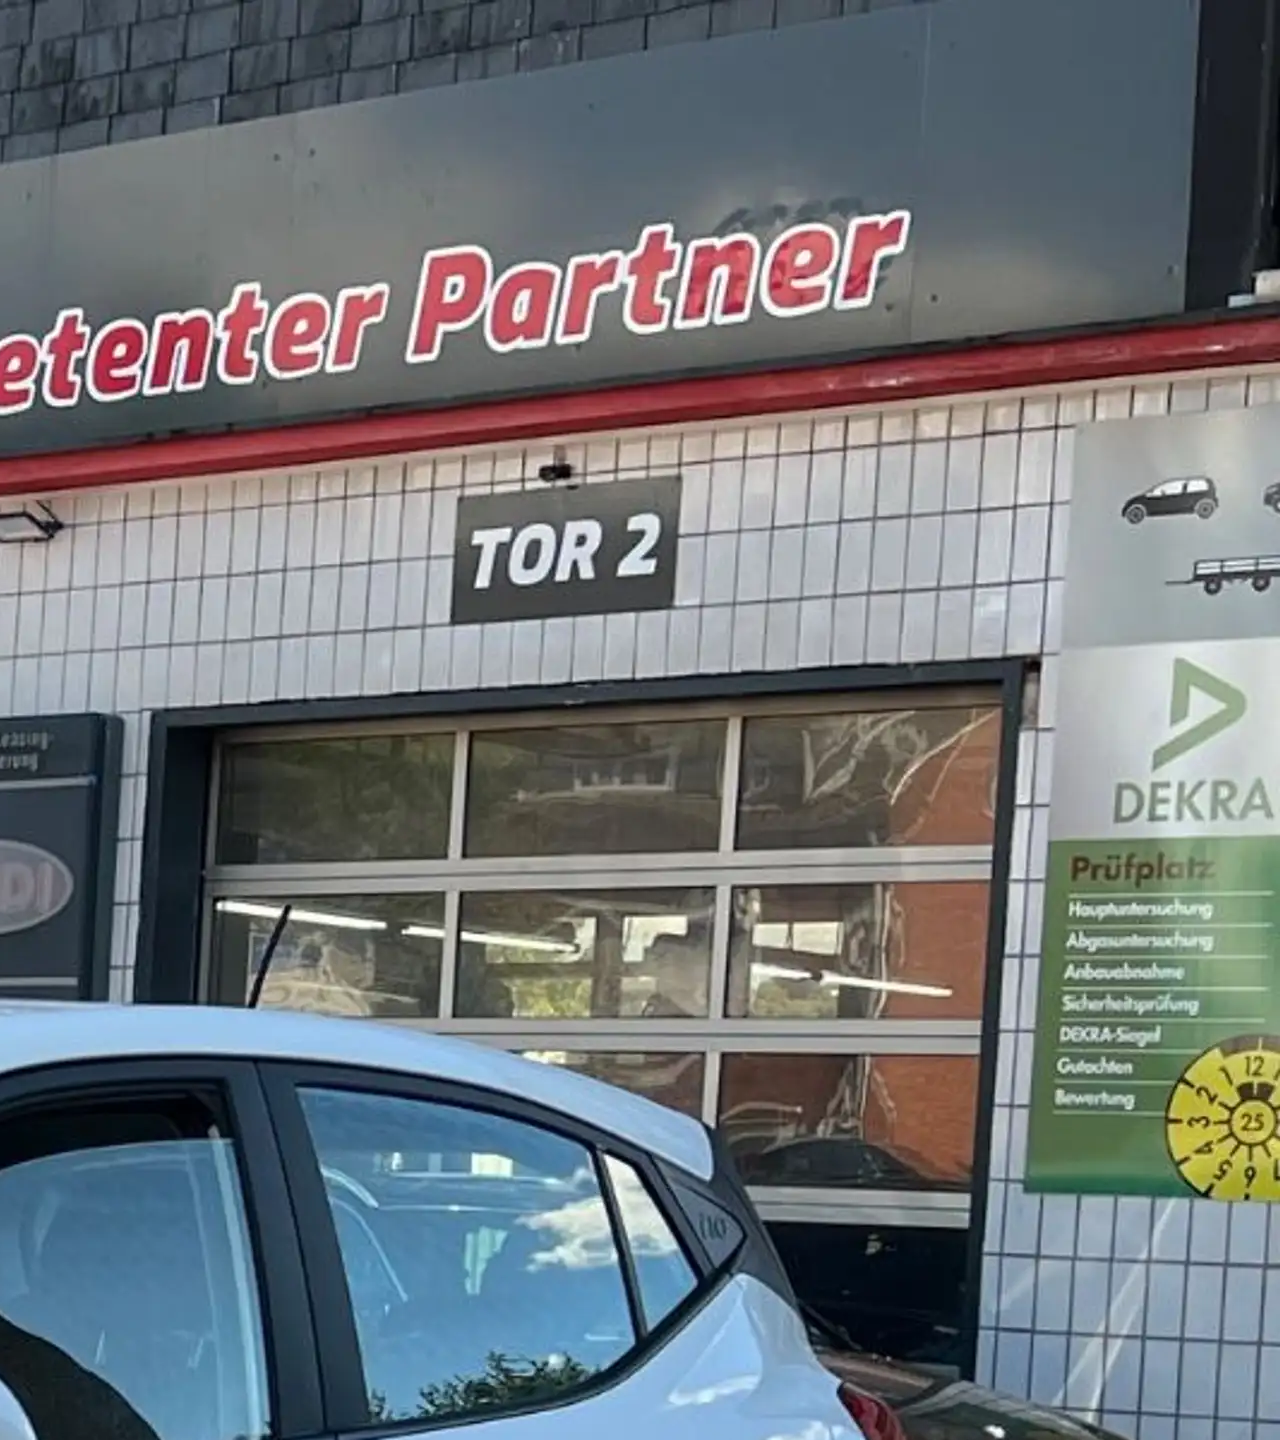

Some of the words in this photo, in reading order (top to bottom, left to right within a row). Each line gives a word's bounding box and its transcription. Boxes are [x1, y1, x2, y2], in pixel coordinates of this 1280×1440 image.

[405, 210, 911, 365] Partner
[469, 520, 604, 591] TOR
[617, 513, 662, 577] 2
[1113, 776, 1275, 824] DEKRA
[1069, 853, 1217, 887] Prüfplatz
[1068, 898, 1213, 920] Hauptuntersuchung
[1065, 932, 1214, 953] Abgasuntersuchung
[1063, 963, 1185, 981] Anbauabnahme
[1061, 993, 1200, 1016] Sicherheitsprüfung
[1059, 1025, 1162, 1047] DEKRA-Siegel
[1056, 1056, 1133, 1075] Gutachten
[1244, 1056, 1265, 1077] 12
[1054, 1088, 1135, 1110] Bewertung
[1240, 1112, 1266, 1132] 25
